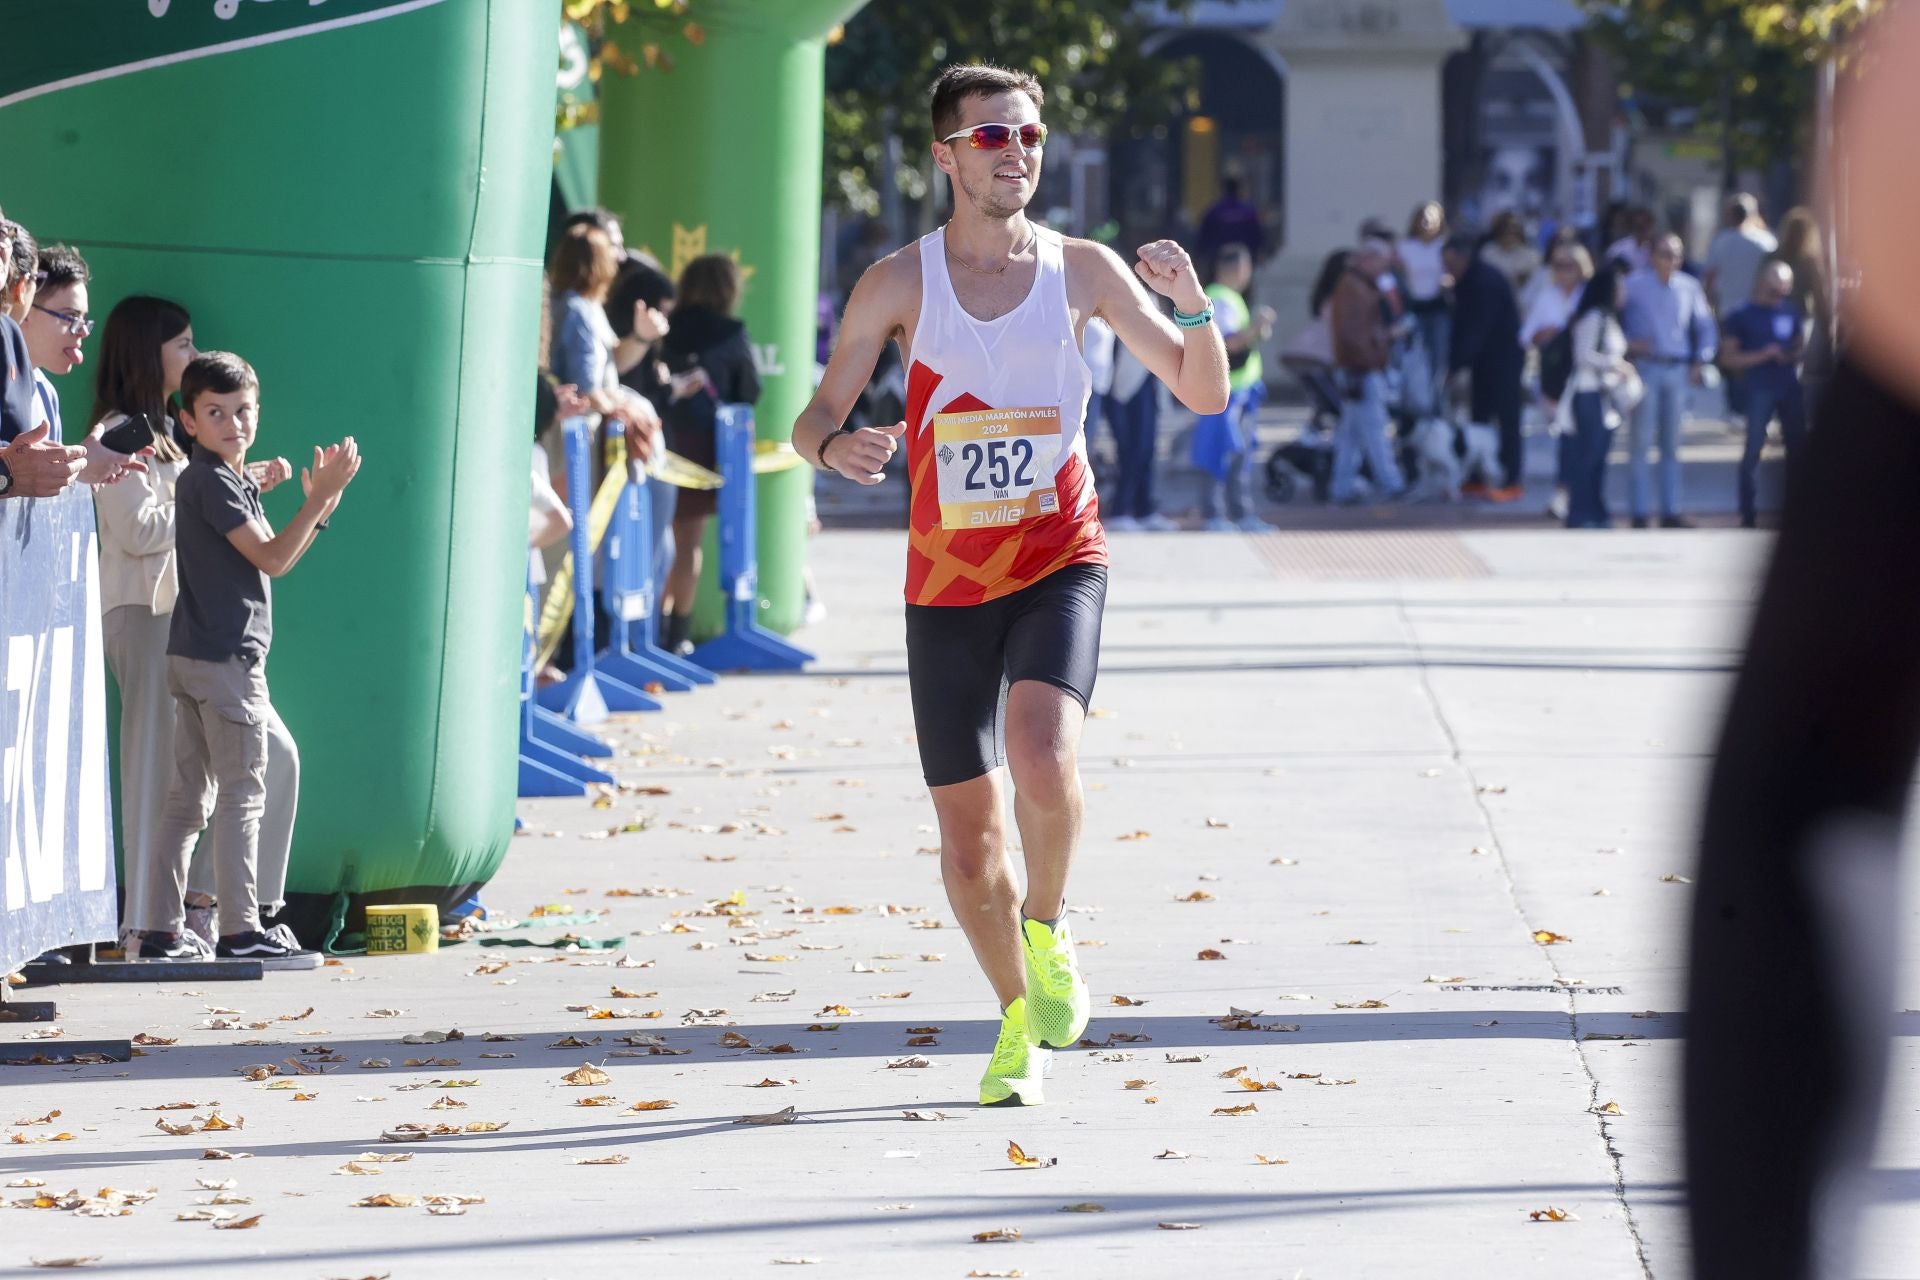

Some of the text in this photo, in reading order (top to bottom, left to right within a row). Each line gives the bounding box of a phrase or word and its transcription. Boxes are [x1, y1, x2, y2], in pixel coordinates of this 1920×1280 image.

[957, 415, 984, 424] MEDIA
[986, 409, 1027, 421] MARATÓN
[1029, 408, 1057, 418] AVILÉS
[982, 424, 1009, 434] 2024
[962, 439, 1035, 490] 252
